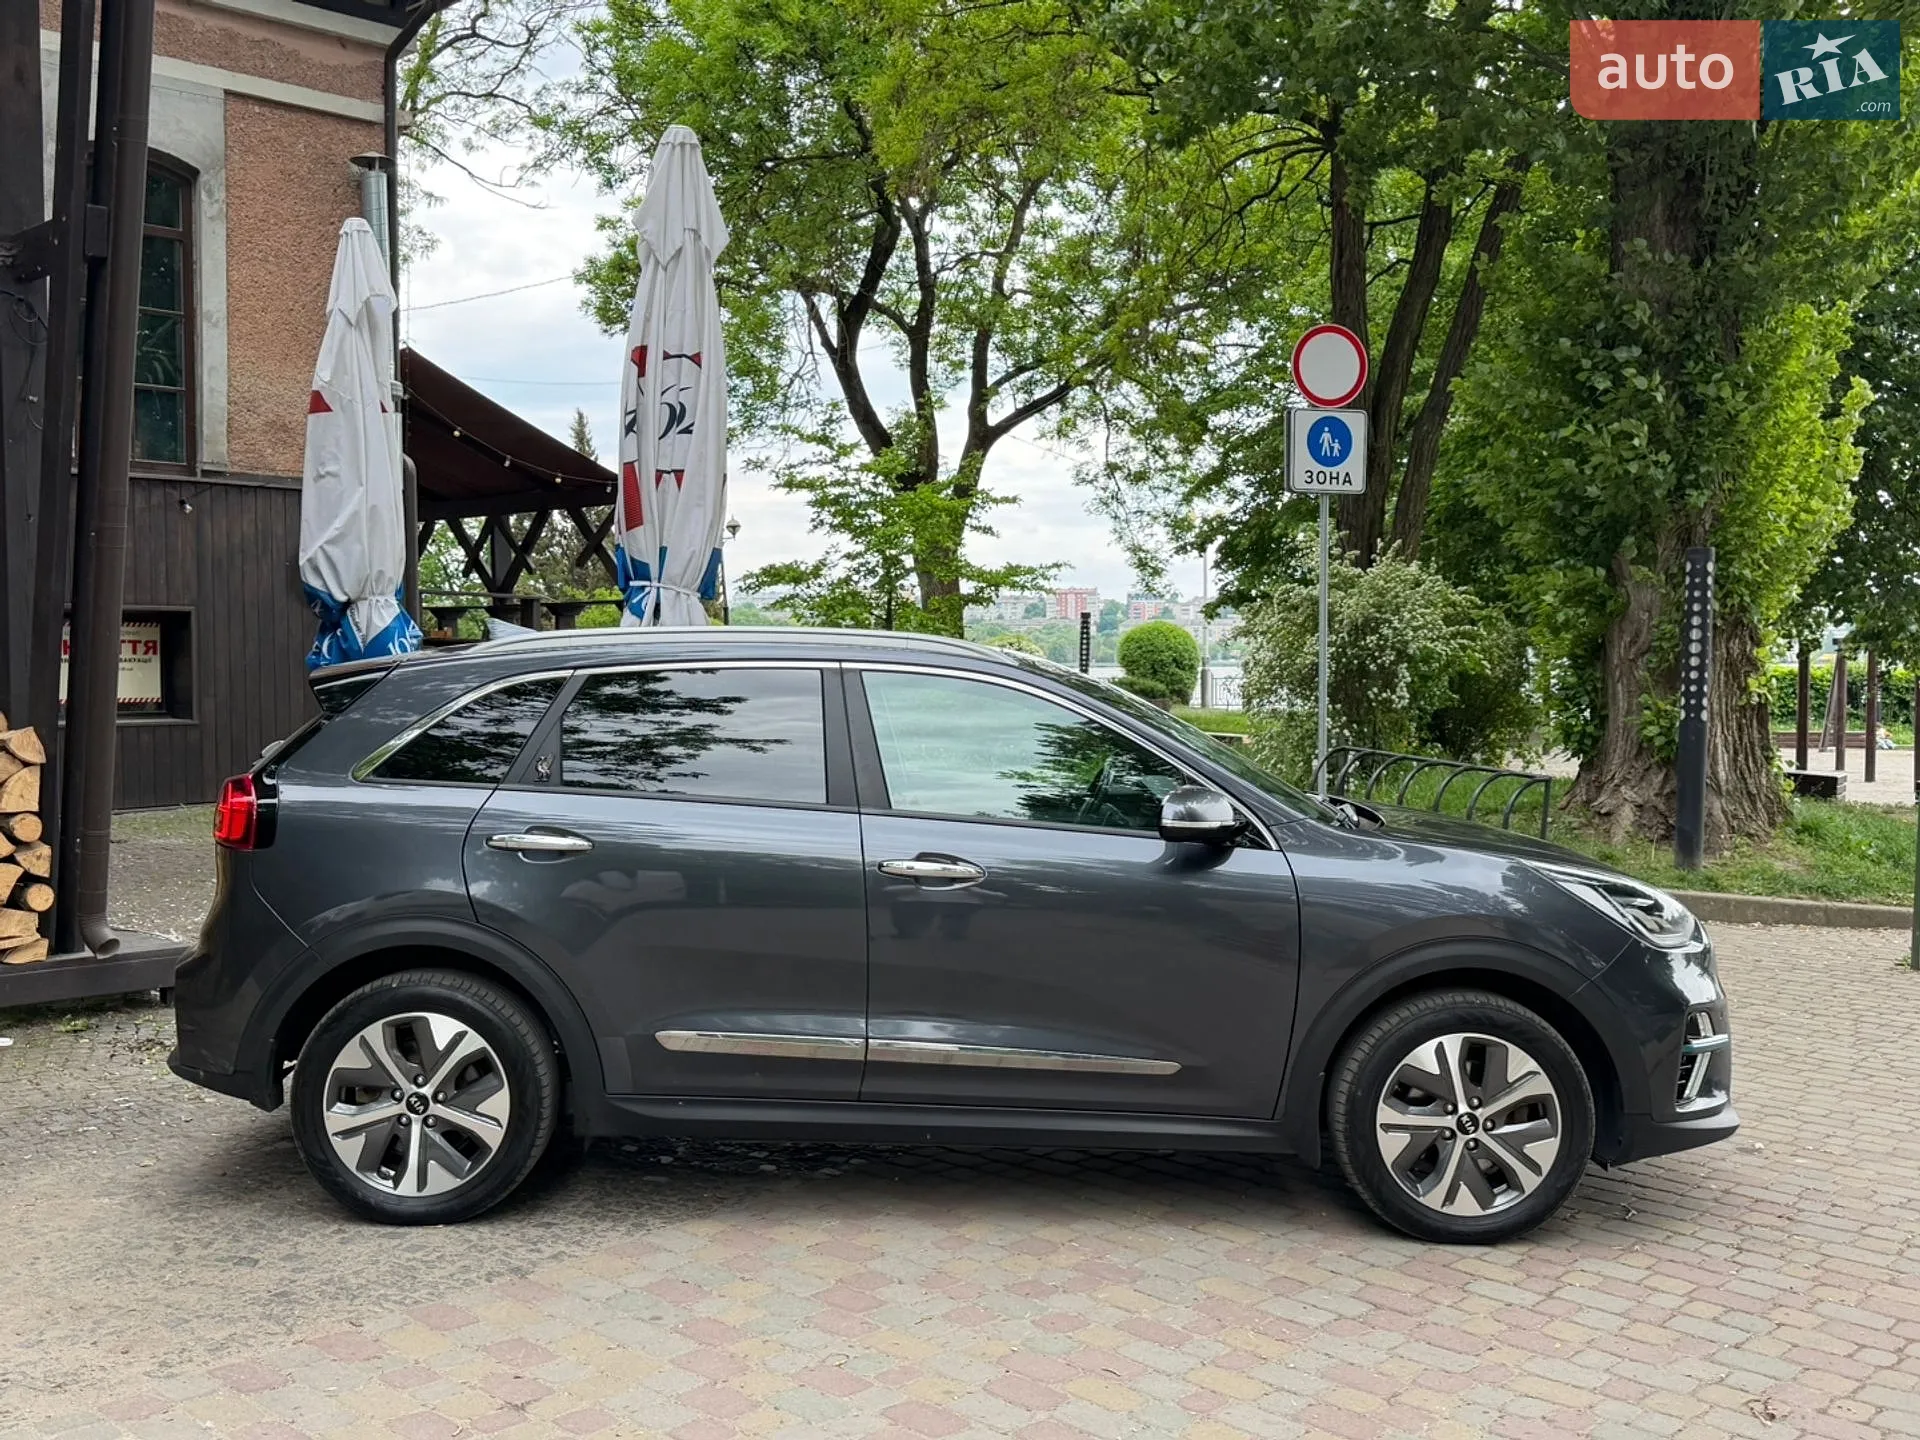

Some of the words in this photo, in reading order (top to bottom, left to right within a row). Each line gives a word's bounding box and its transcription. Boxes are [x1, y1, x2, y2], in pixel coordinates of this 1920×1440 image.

[1304, 469, 1353, 486] ЗОНА
[408, 1094, 425, 1113] KIA
[1460, 1114, 1476, 1134] KIA
